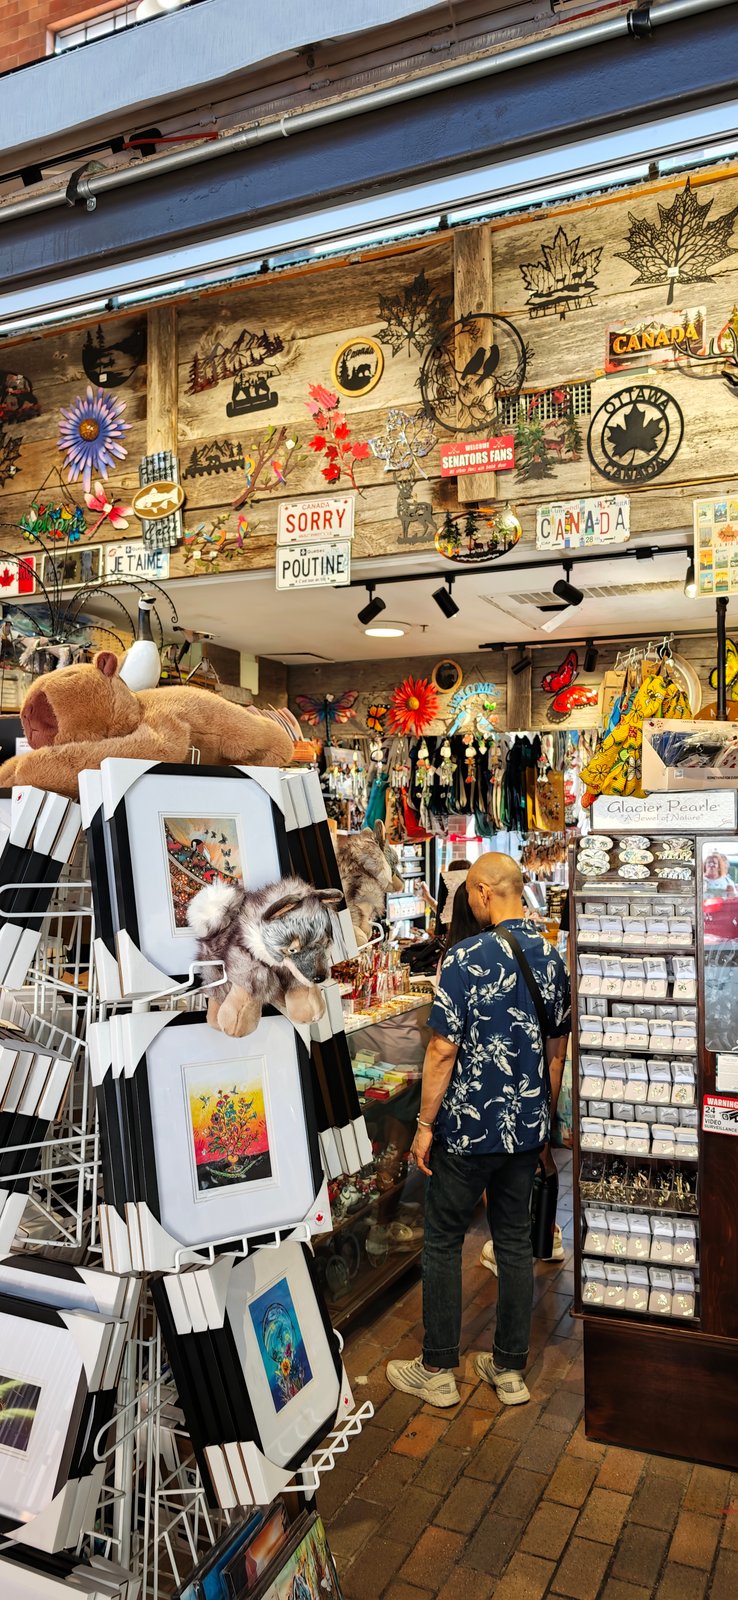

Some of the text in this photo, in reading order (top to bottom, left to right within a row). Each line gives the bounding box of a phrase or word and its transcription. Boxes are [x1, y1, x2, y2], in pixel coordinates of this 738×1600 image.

[612, 323, 699, 354] CANADA
[604, 387, 670, 414] OTTAWA
[442, 447, 513, 469] SENATORS FANS
[464, 442, 490, 451] WELCOME
[603, 457, 667, 480] CANADA
[302, 501, 330, 511] CANADA
[286, 508, 346, 533] SORRY
[540, 507, 626, 541] CANADA
[110, 551, 162, 574] JE T'AIME
[282, 554, 345, 579] POUTINE
[607, 798, 718, 813] Glacier Pearle
[705, 1106, 716, 1114] 24
[705, 1118, 722, 1126] VIDEO
